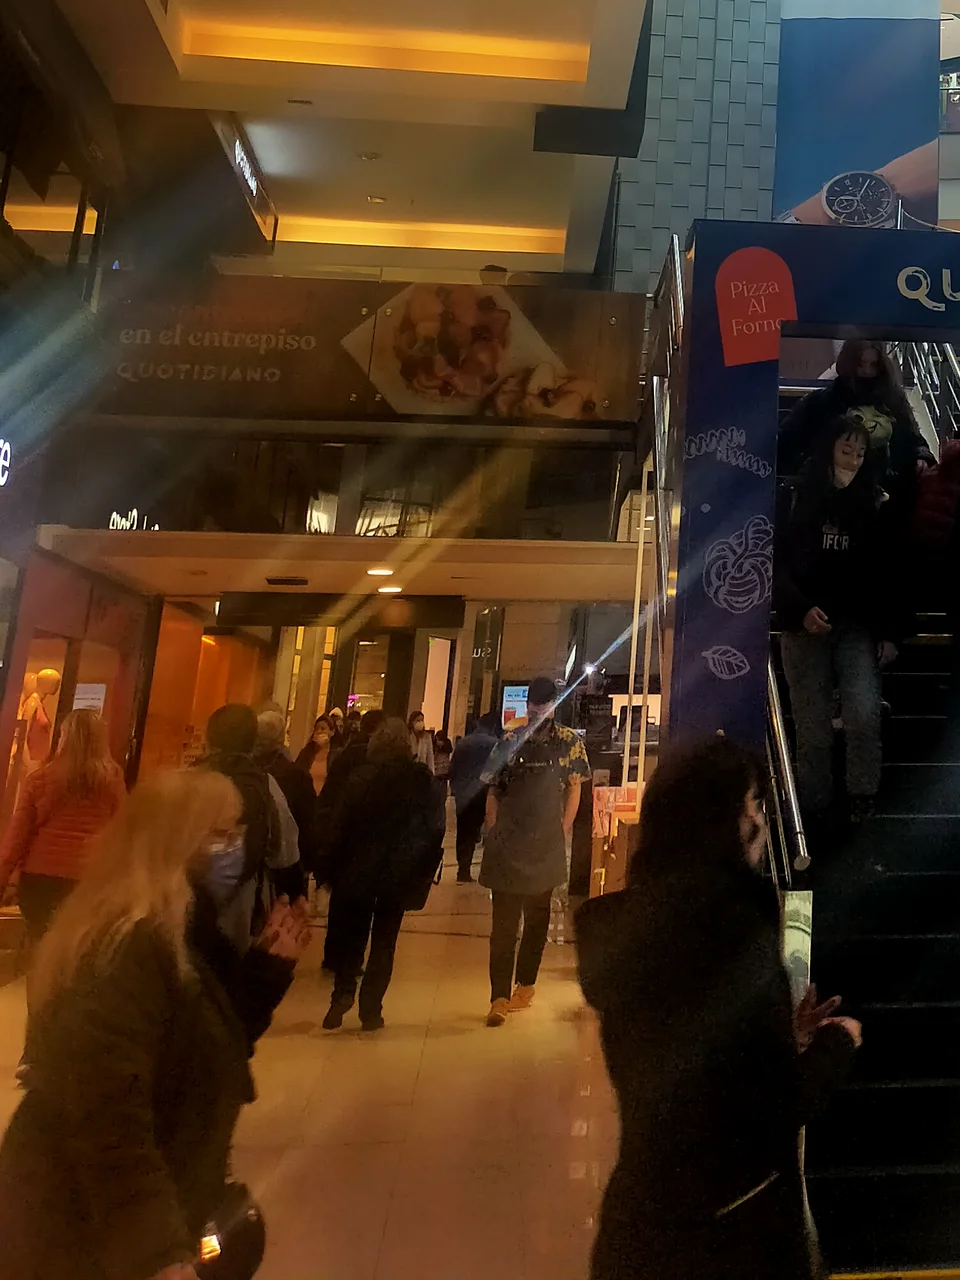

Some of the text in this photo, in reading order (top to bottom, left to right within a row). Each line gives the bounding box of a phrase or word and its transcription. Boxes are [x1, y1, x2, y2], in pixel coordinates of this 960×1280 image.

[730, 280, 780, 299] Pizza
[748, 296, 767, 315] Al
[119, 323, 317, 355] en el entrepiso
[116, 361, 282, 382] QUOTIDIANO
